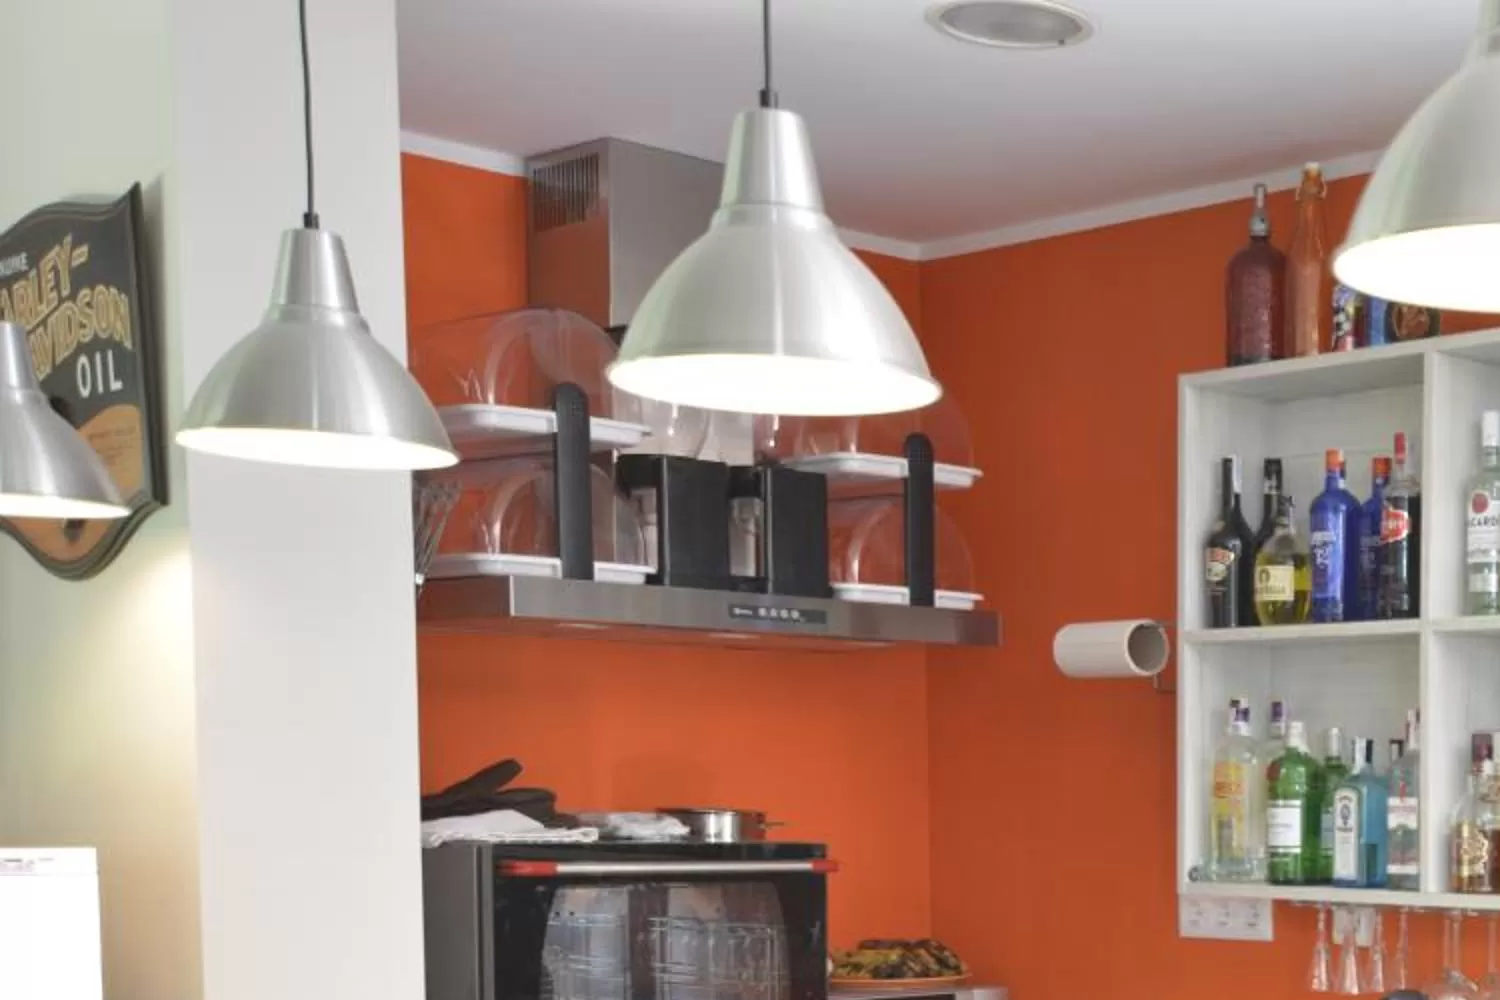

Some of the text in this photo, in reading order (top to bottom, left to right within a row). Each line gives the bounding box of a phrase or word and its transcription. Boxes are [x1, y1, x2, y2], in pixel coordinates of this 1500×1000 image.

[0, 232, 89, 331] ARLEY-
[28, 284, 132, 381] VIDSON
[76, 349, 123, 398] OIL
